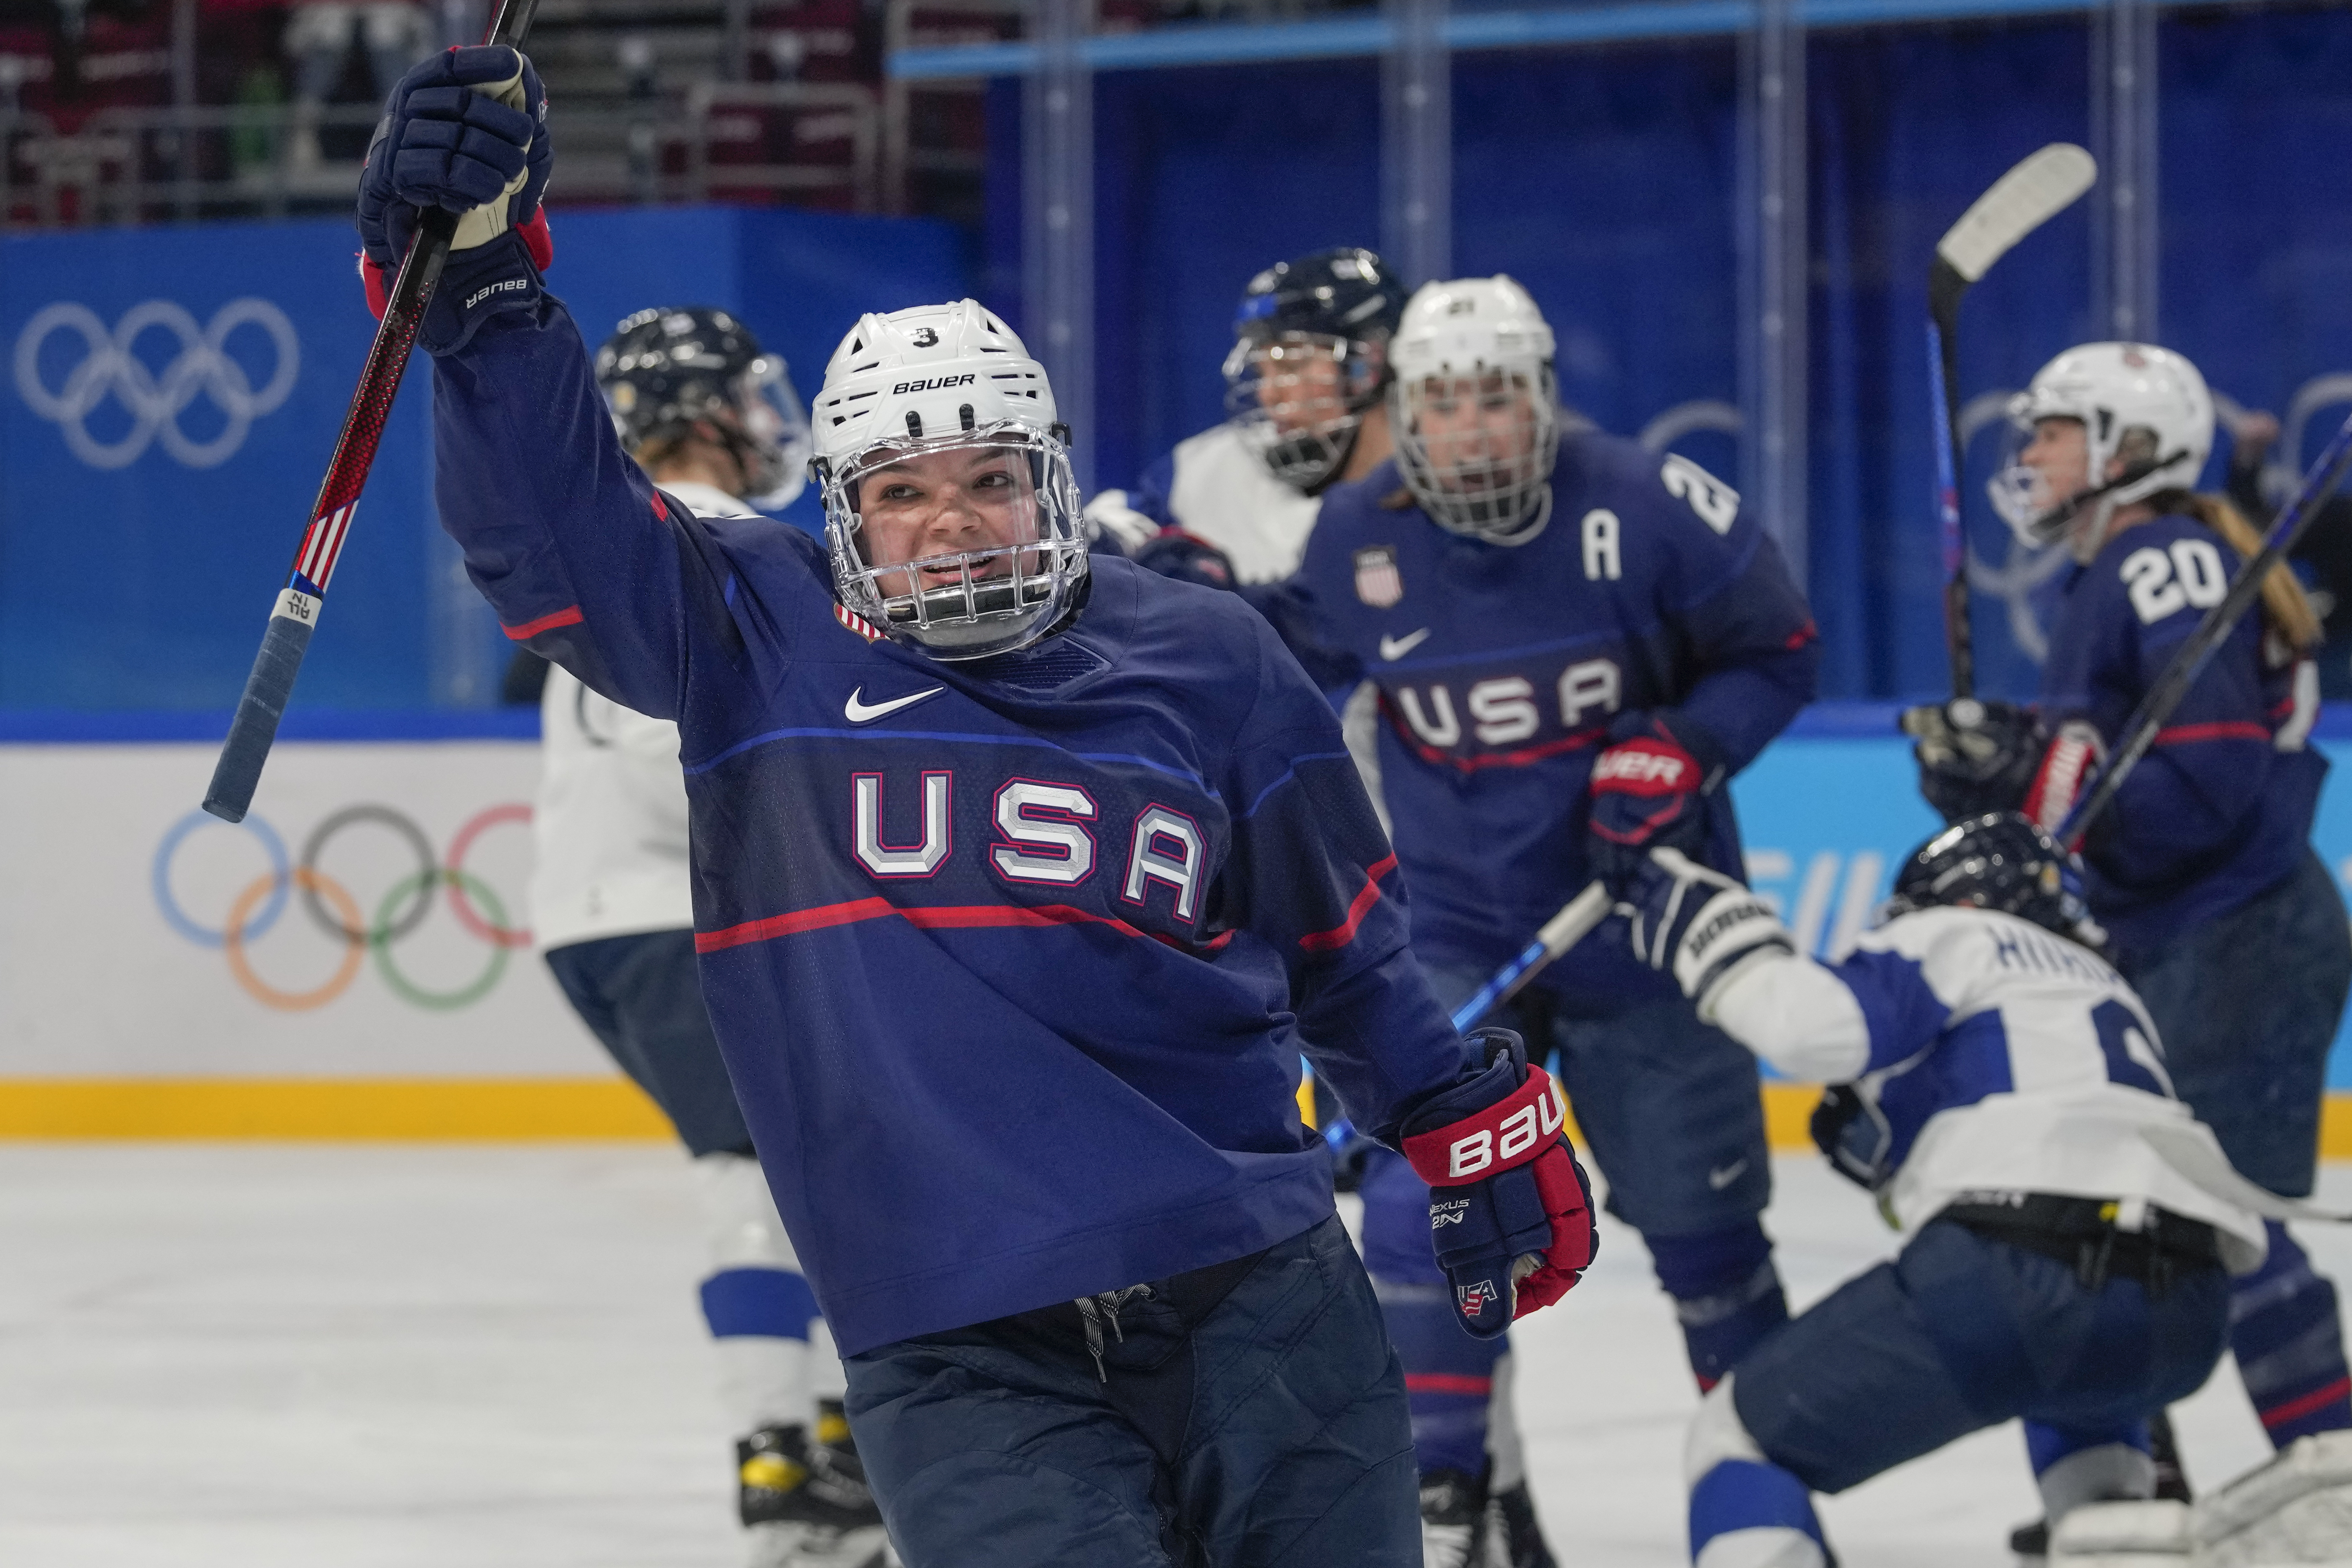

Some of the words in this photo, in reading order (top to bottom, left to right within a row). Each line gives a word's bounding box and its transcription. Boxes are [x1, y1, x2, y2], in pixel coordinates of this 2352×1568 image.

[912, 327, 939, 348] 3
[1660, 453, 1741, 535] 2
[1581, 508, 1621, 581] A
[2120, 539, 2229, 625] 20
[1399, 659, 1621, 747] USA
[852, 770, 1207, 925] USA
[1449, 1073, 1565, 1178] BAU
[1429, 1198, 1470, 1217] NEXUS
[1458, 1279, 1498, 1318] USA
